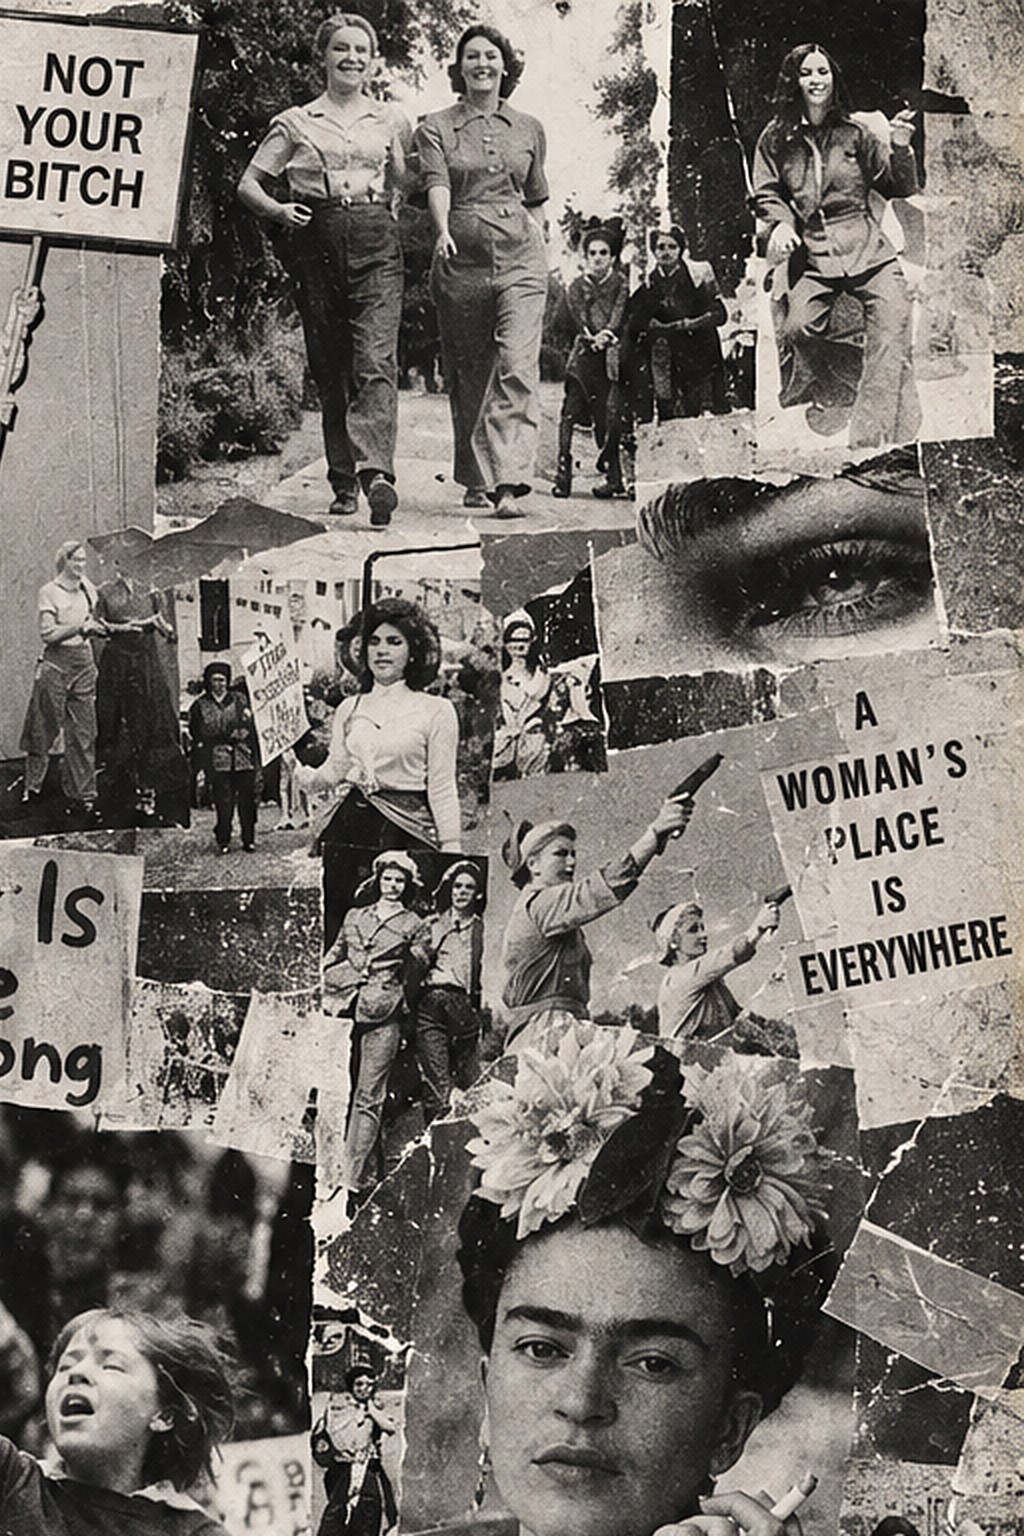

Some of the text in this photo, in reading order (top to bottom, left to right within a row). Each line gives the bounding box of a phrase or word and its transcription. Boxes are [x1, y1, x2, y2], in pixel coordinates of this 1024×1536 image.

[43, 53, 144, 98] NOT
[16, 105, 143, 154] YOUR
[4, 160, 144, 209] BITCH
[854, 690, 877, 730] A
[777, 739, 968, 812] WOMAN'S
[825, 806, 944, 865] PLACE
[871, 876, 905, 916] IS
[799, 915, 1012, 995] EVERYWHERE
